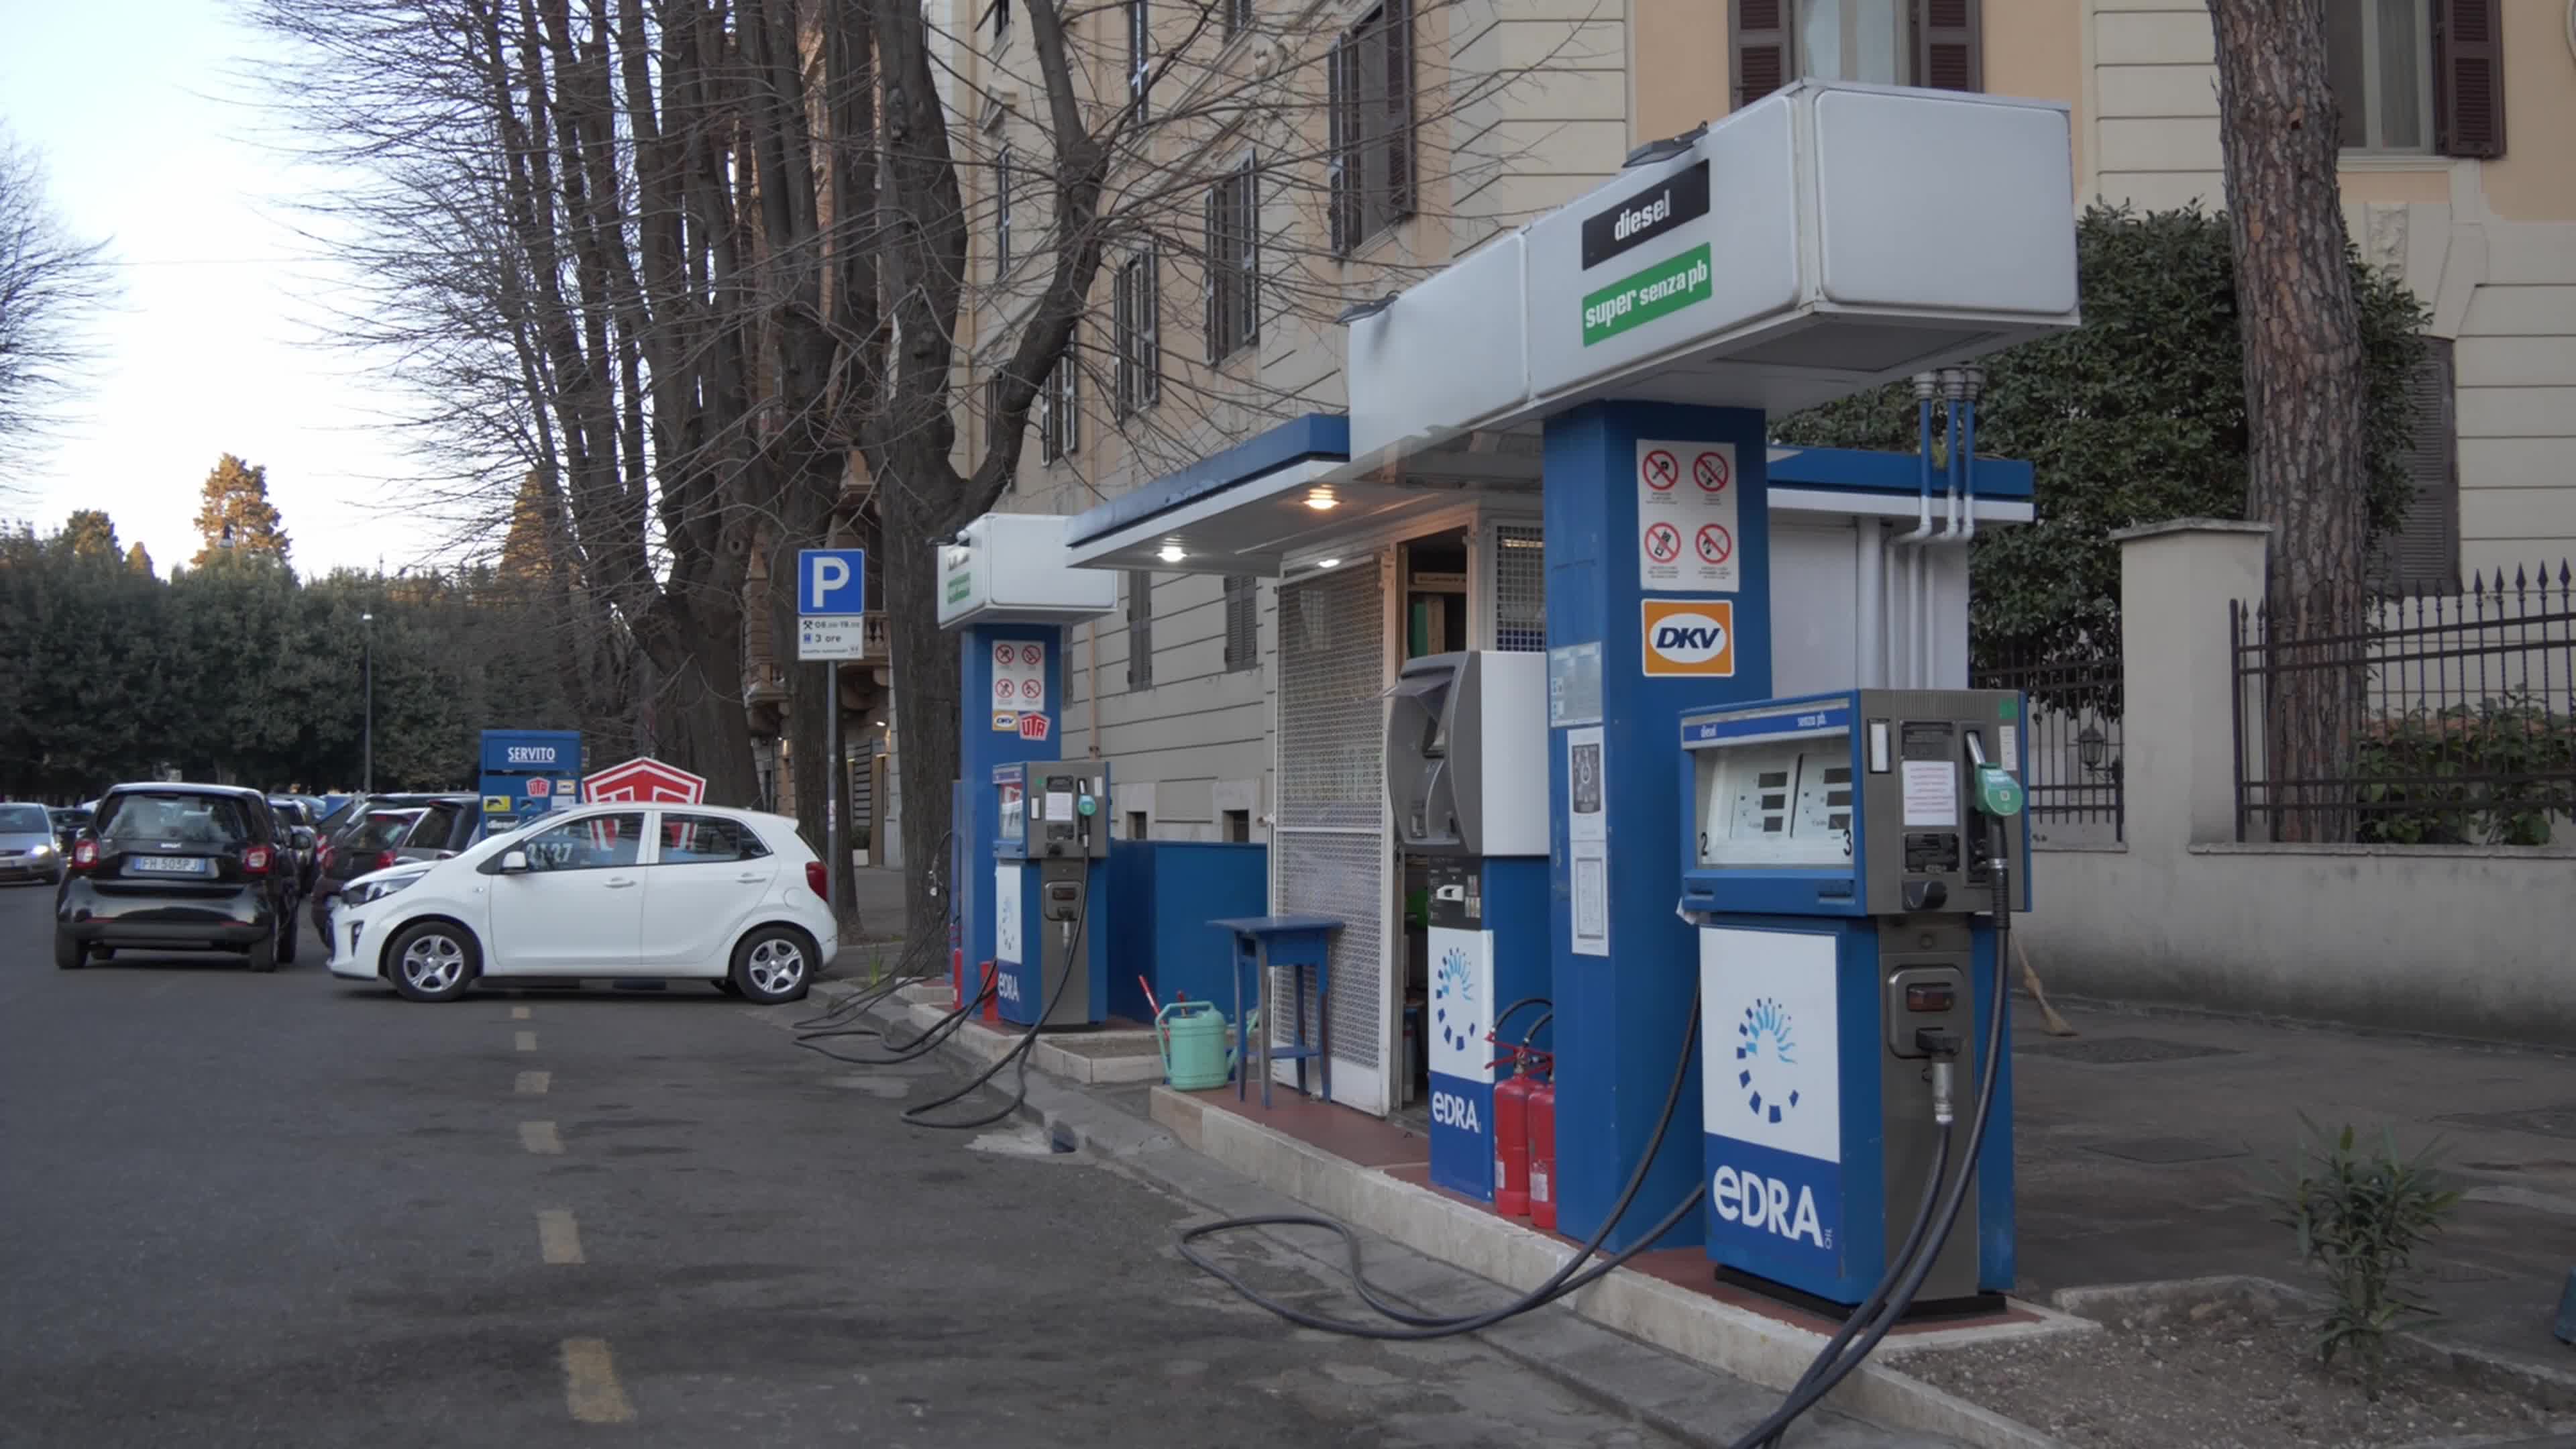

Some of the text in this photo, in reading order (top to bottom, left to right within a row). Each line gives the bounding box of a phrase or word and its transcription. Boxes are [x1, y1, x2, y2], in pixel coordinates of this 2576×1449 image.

[1614, 189, 1671, 241] diesel
[1585, 259, 1708, 328] super senza pb
[812, 556, 850, 608] P
[1656, 627, 1721, 649] DKV
[1022, 714, 1046, 736] UTA
[508, 747, 555, 761] SERVITO
[1701, 831, 1709, 857] 2
[1843, 828, 1852, 856] 3
[1713, 1165, 1824, 1248] eDRA
